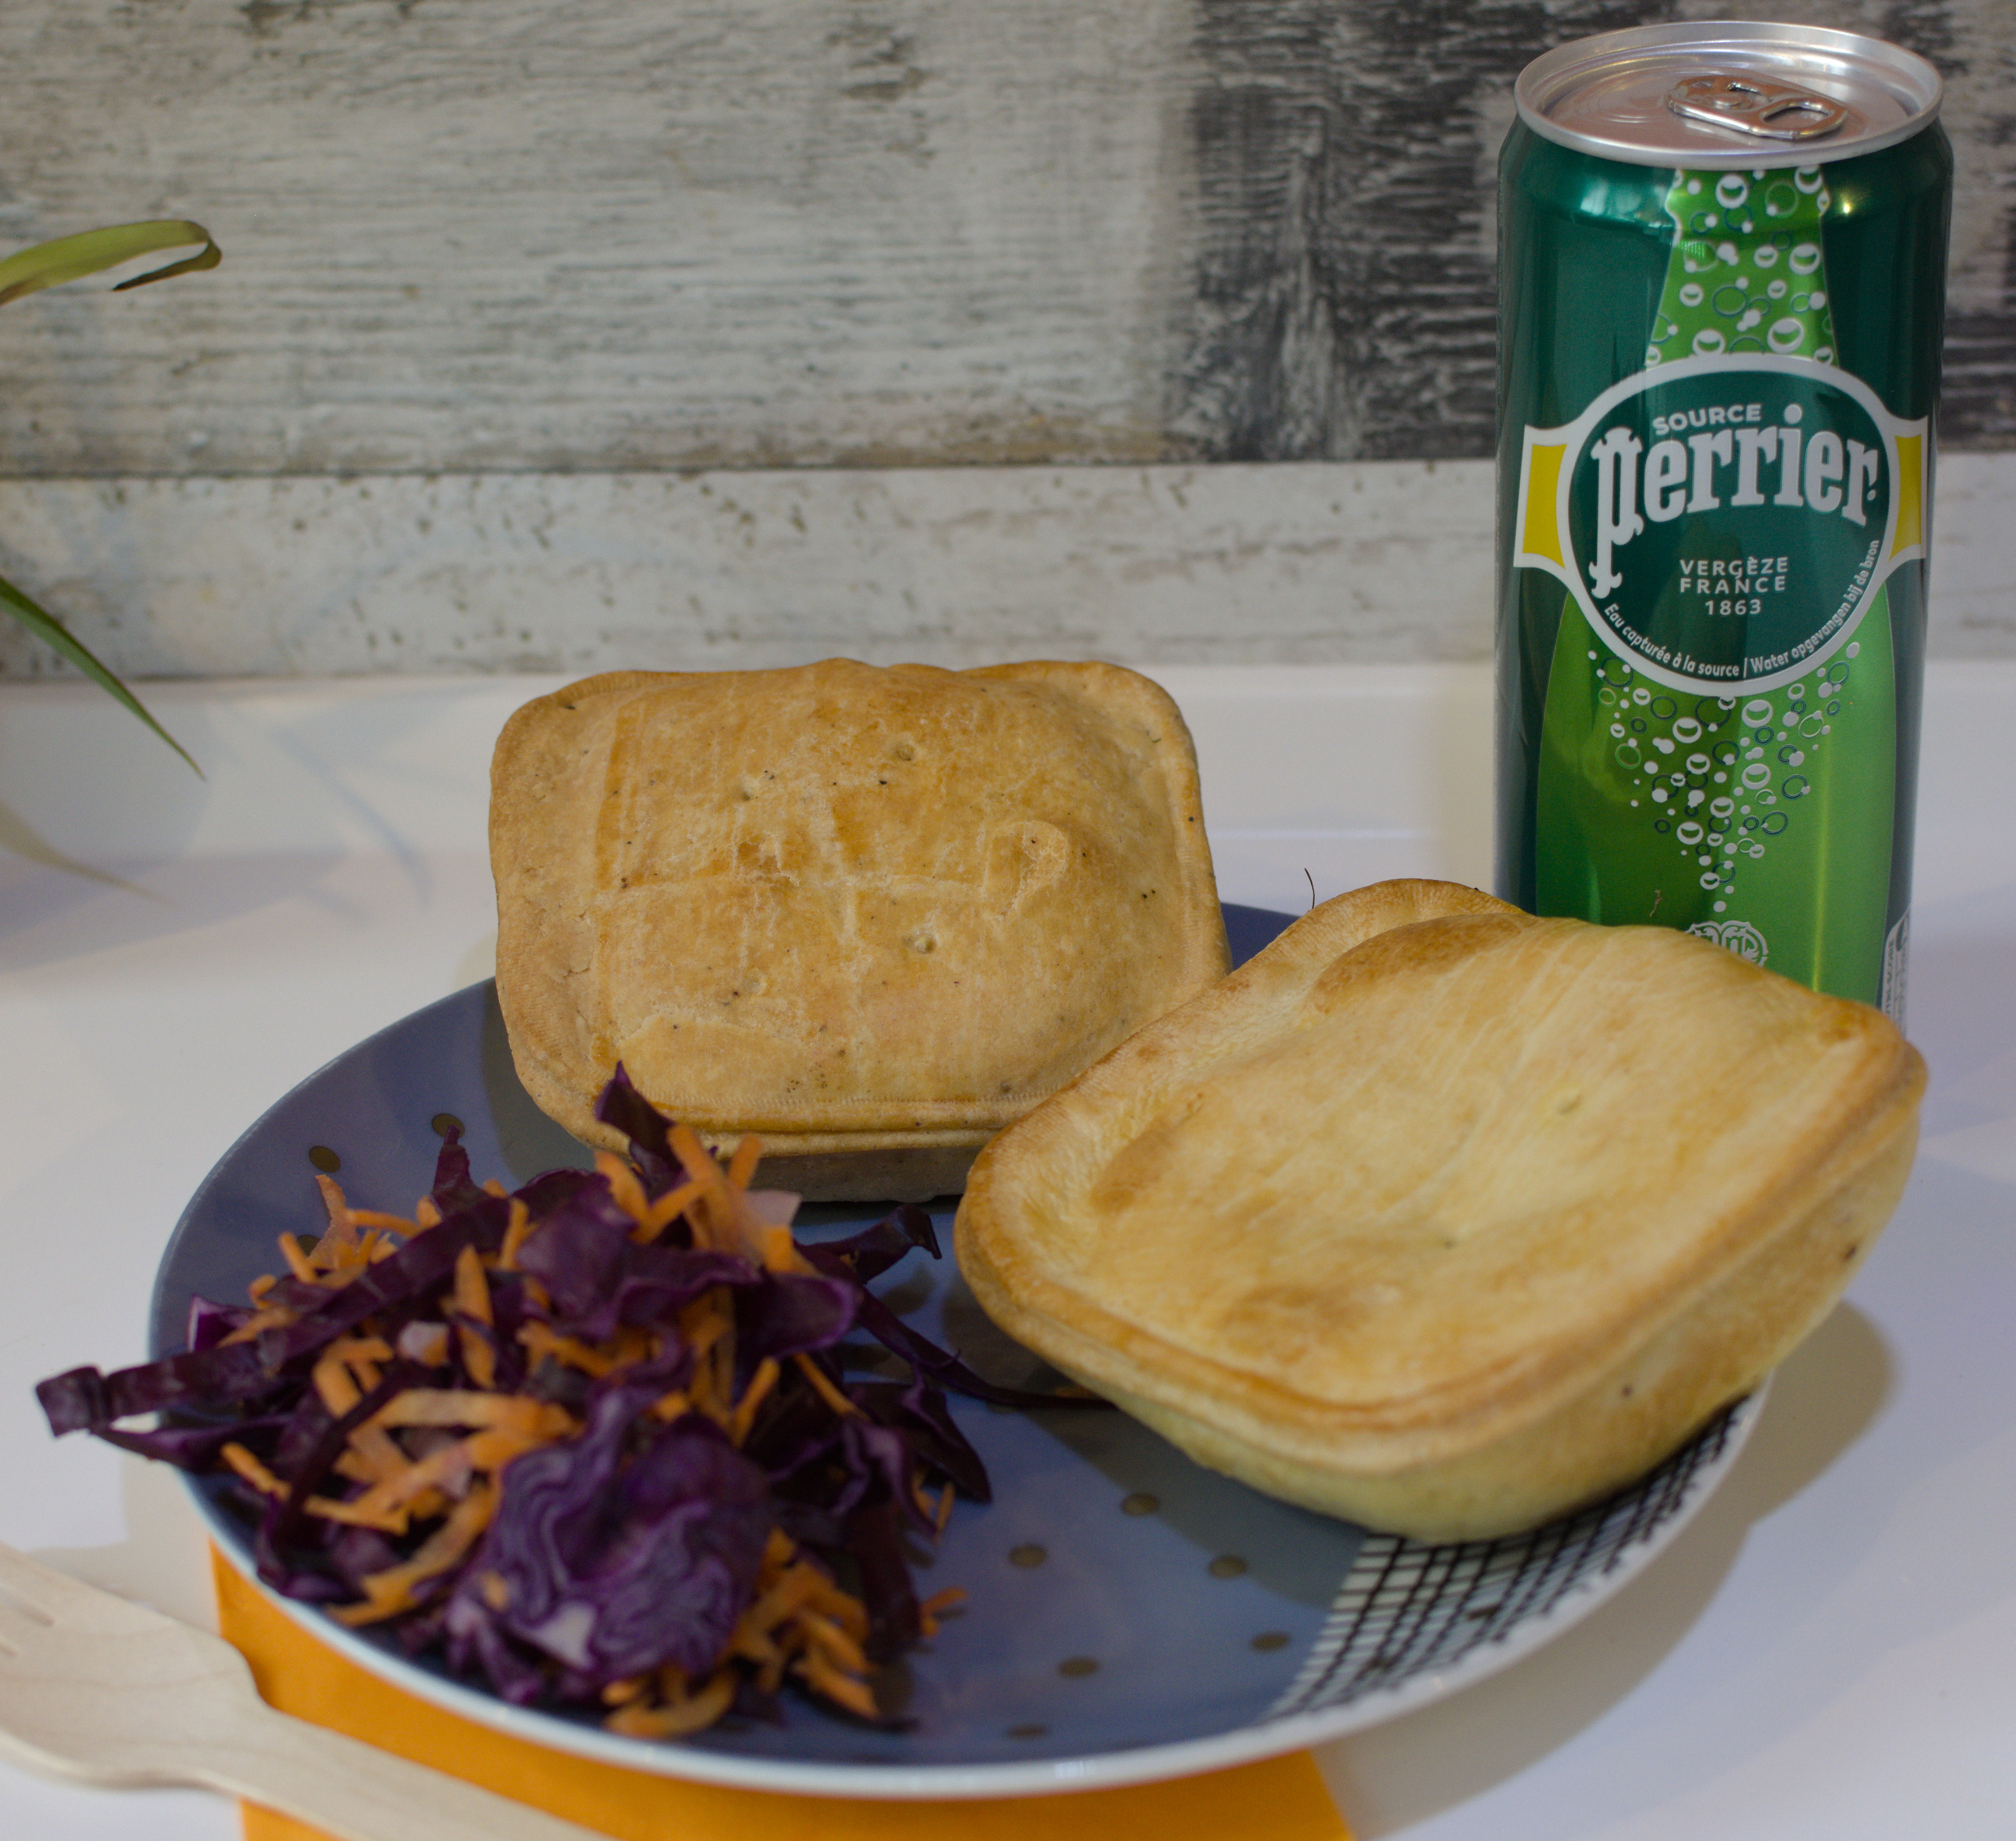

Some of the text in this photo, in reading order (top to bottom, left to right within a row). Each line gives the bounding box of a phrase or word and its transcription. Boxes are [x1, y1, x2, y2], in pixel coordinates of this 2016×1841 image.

[1652, 403, 1762, 435] SOURCE
[1860, 540, 1879, 568] bron
[1679, 556, 1788, 579] VERGÈZE
[1854, 570, 1869, 585] de
[1680, 575, 1786, 594] FRANCE
[1843, 584, 1863, 603] bij
[1604, 603, 1625, 628] Eau
[1705, 599, 1761, 615] 1863
[1791, 602, 1851, 658] opgevangen
[1622, 625, 1671, 663] capturée
[1672, 652, 1682, 668] à
[1683, 654, 1696, 673] la
[1698, 663, 1740, 676] source
[1750, 652, 1789, 673] Water
